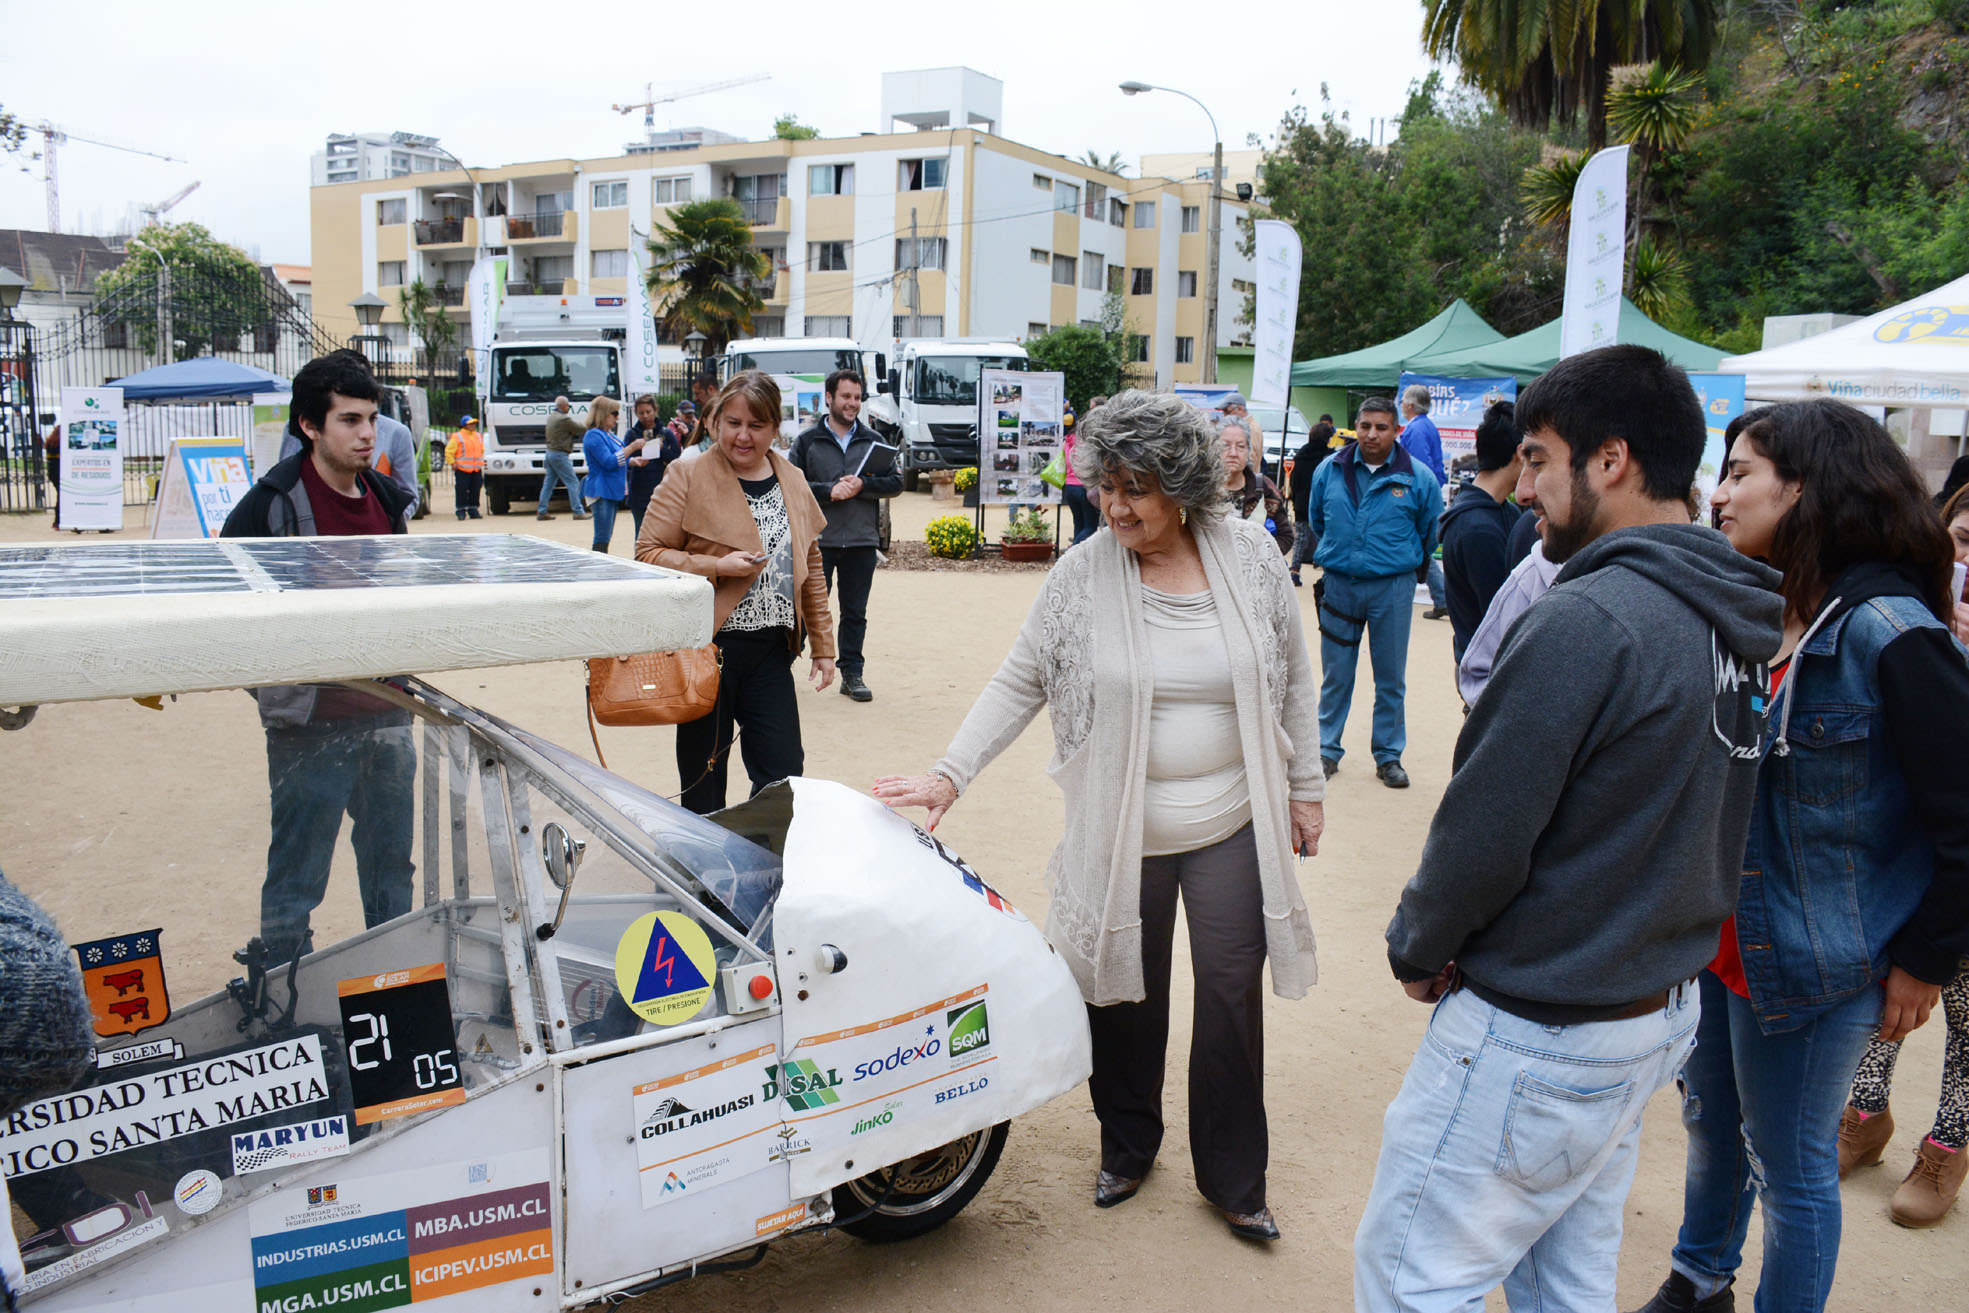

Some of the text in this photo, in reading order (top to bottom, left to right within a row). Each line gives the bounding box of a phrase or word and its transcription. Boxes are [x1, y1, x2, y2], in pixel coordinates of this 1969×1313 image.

[1429, 384, 1456, 398] BÍAS
[646, 1005, 662, 1015] TIRE
[112, 1043, 163, 1064] SOLEM
[349, 1013, 392, 1071] 21
[852, 1038, 941, 1082] sodexo
[952, 1027, 987, 1053] SQM
[413, 1050, 458, 1089] 05
[0, 1042, 314, 1138] RSIDAD TECNICA
[934, 1077, 989, 1105] BELLO
[0, 1077, 328, 1177] ICO SANTA MARIA
[234, 1117, 345, 1154] MARYUN
[641, 1094, 755, 1140] COLLAHUASI
[414, 1198, 547, 1239] MBA.USM.CL
[256, 1228, 406, 1268] INDUSTRIAS.USM.CL
[414, 1243, 551, 1286] ICIPEV.USM.CL
[260, 1273, 407, 1313] MGA.USM.CL
